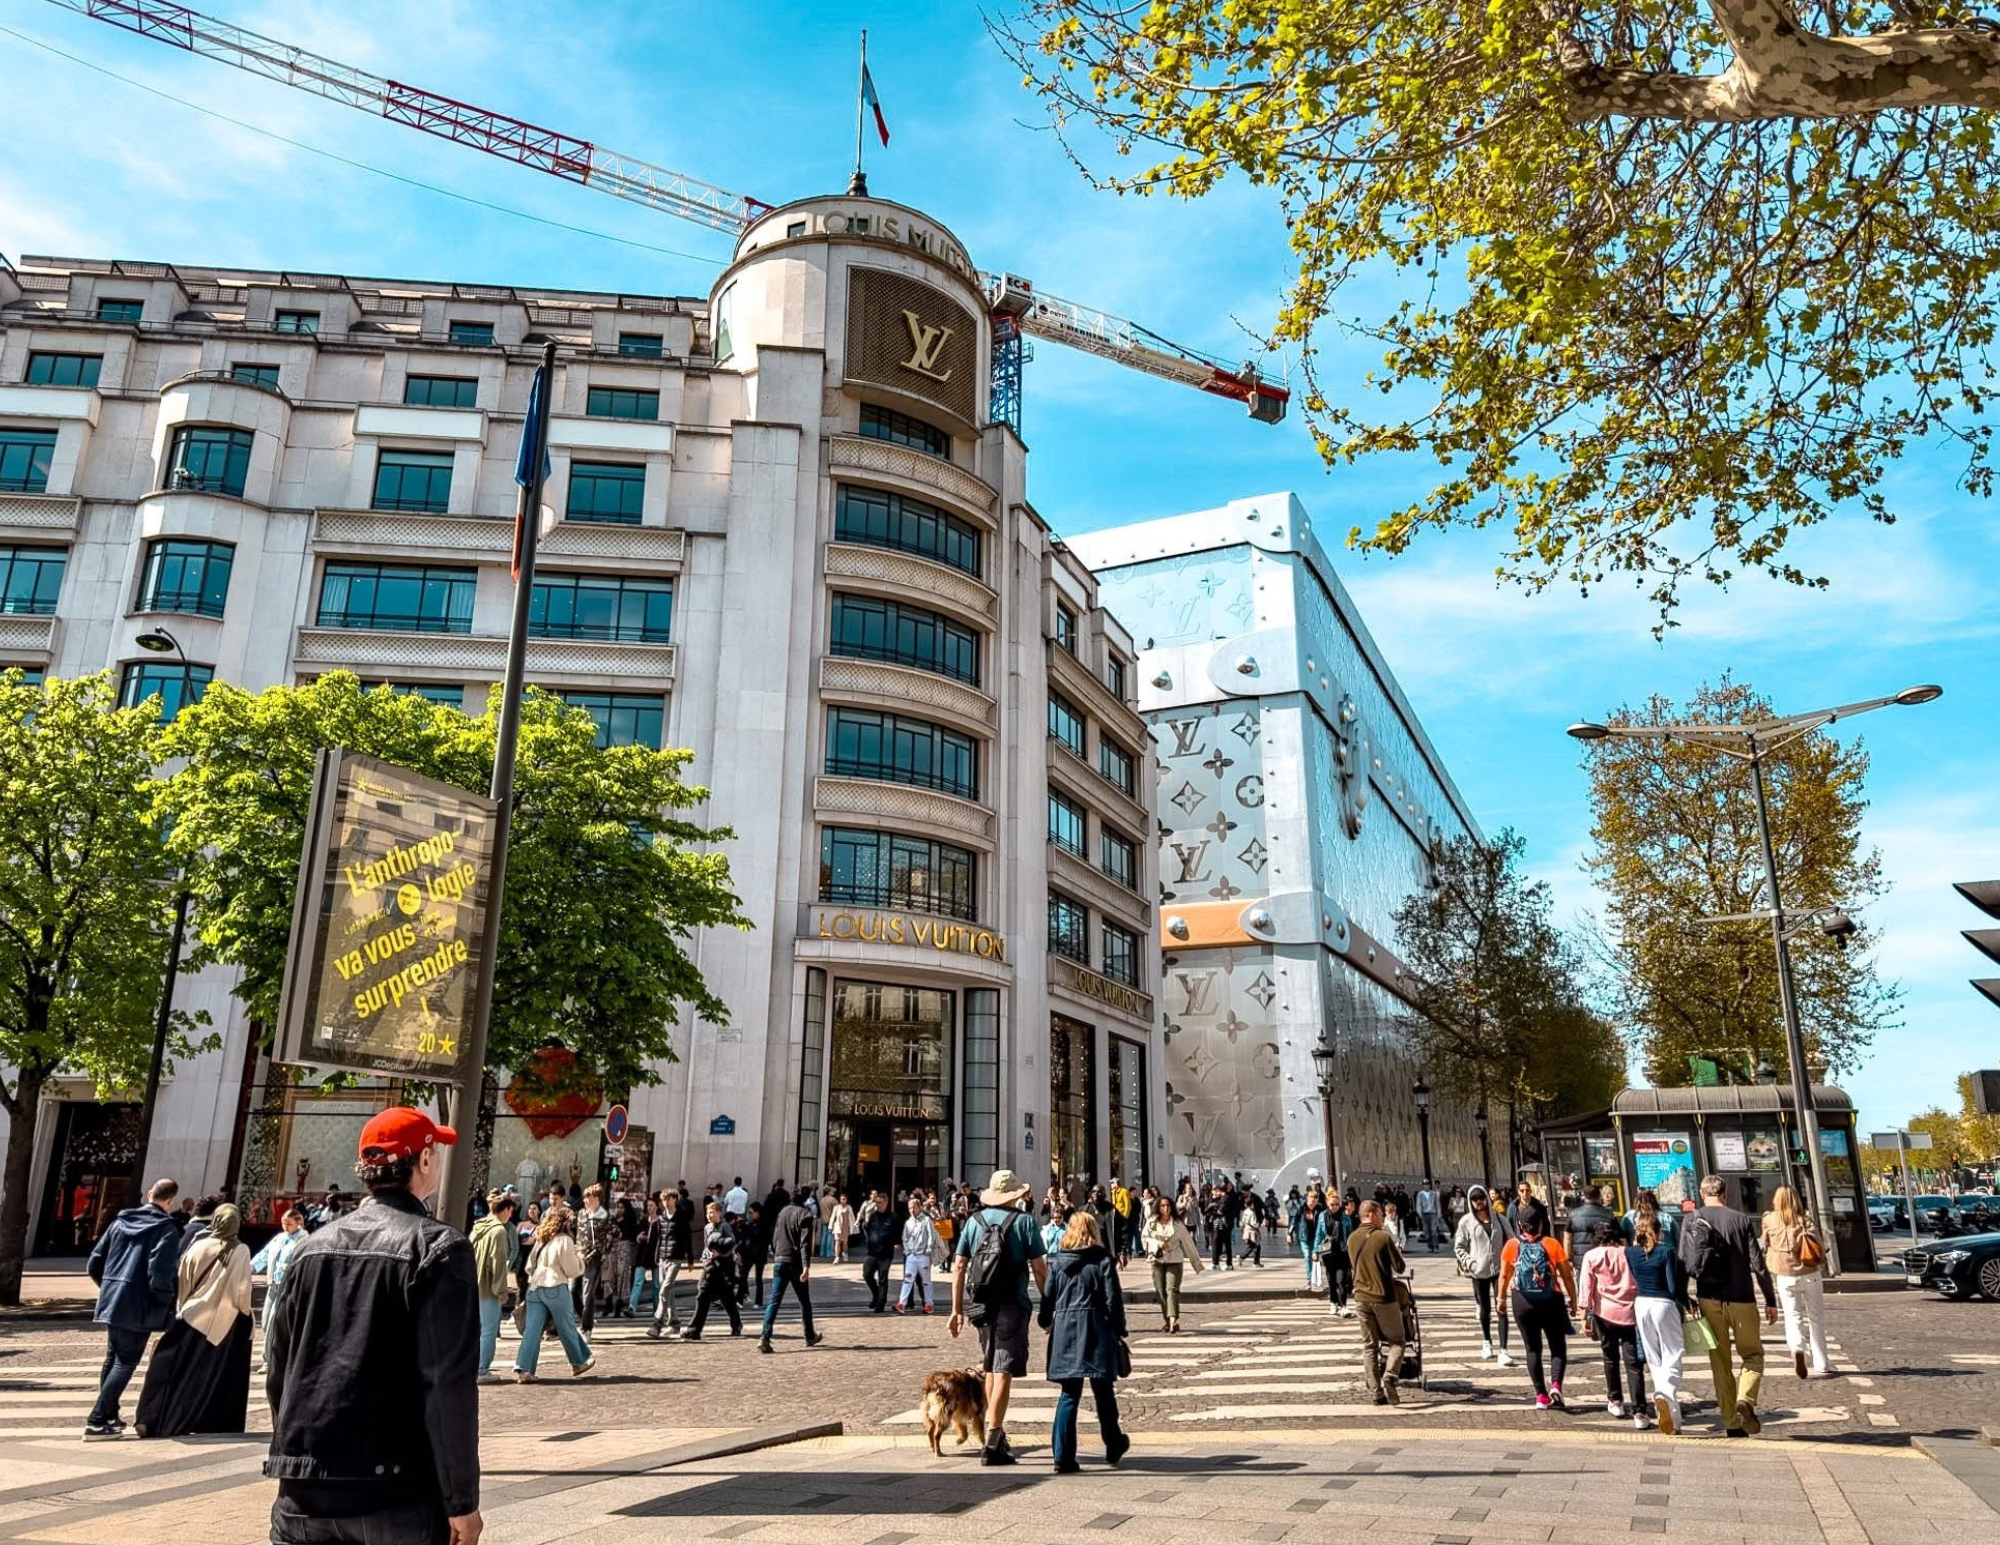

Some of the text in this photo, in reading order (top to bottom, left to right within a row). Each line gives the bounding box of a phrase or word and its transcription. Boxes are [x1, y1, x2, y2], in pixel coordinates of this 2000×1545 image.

[812, 210, 900, 241] LOUIS
[344, 830, 462, 898] L'anthropo-
[425, 859, 476, 902] logie
[334, 949, 365, 981] va
[363, 922, 417, 965] vous
[819, 912, 1005, 961] LOUIS VUITTON
[354, 939, 468, 1019] surprendre
[1075, 970, 1140, 1014] LOUIS VUITTON
[418, 1032, 436, 1054] 20
[854, 1103, 929, 1119] LOUIS VUITTON
